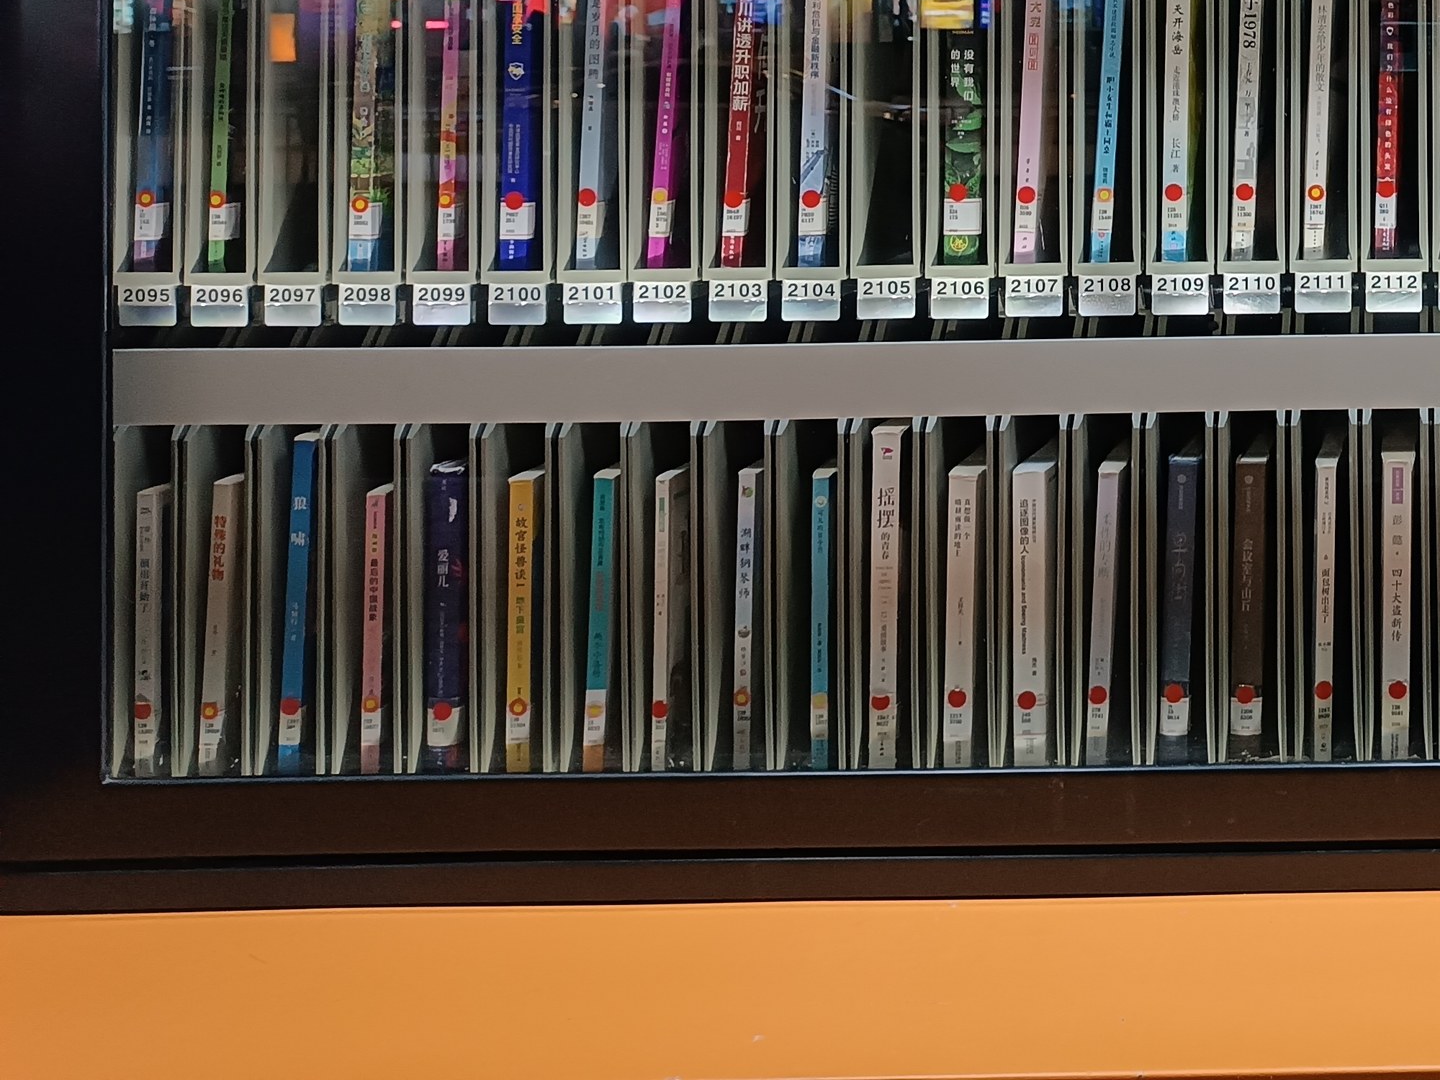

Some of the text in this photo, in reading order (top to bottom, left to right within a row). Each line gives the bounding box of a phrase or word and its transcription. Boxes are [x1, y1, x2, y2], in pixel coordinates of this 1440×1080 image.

[1172, 3, 1184, 56] 天开海岳
[951, 49, 962, 88] 的世界
[963, 49, 975, 102] 没有我们
[1170, 137, 1181, 159] 长江
[862, 280, 911, 296] 2105
[936, 281, 985, 295] 2106
[1010, 278, 1058, 293] 2107
[1084, 277, 1131, 293] 2108
[1157, 277, 1204, 292] 2109
[1228, 276, 1276, 291] 2110
[1300, 275, 1344, 289] 2111
[1371, 275, 1417, 289] 2112
[123, 288, 170, 303] 2095
[196, 288, 243, 303] 2096
[269, 288, 316, 303] 2097
[344, 287, 391, 302] 2098
[418, 287, 465, 302] 2099
[494, 287, 541, 302] 2100
[568, 285, 613, 301] 2101
[638, 284, 686, 299] 2102
[714, 283, 762, 298] 2103
[787, 283, 836, 297] 2104
[1018, 499, 1029, 554] 追逐图像的人
[213, 515, 227, 582] 特殊的礼物
[437, 549, 449, 588] 爱丽儿
[738, 528, 752, 599] 湖畔钢琴师
[1390, 568, 1403, 642] 四十大盗新传
